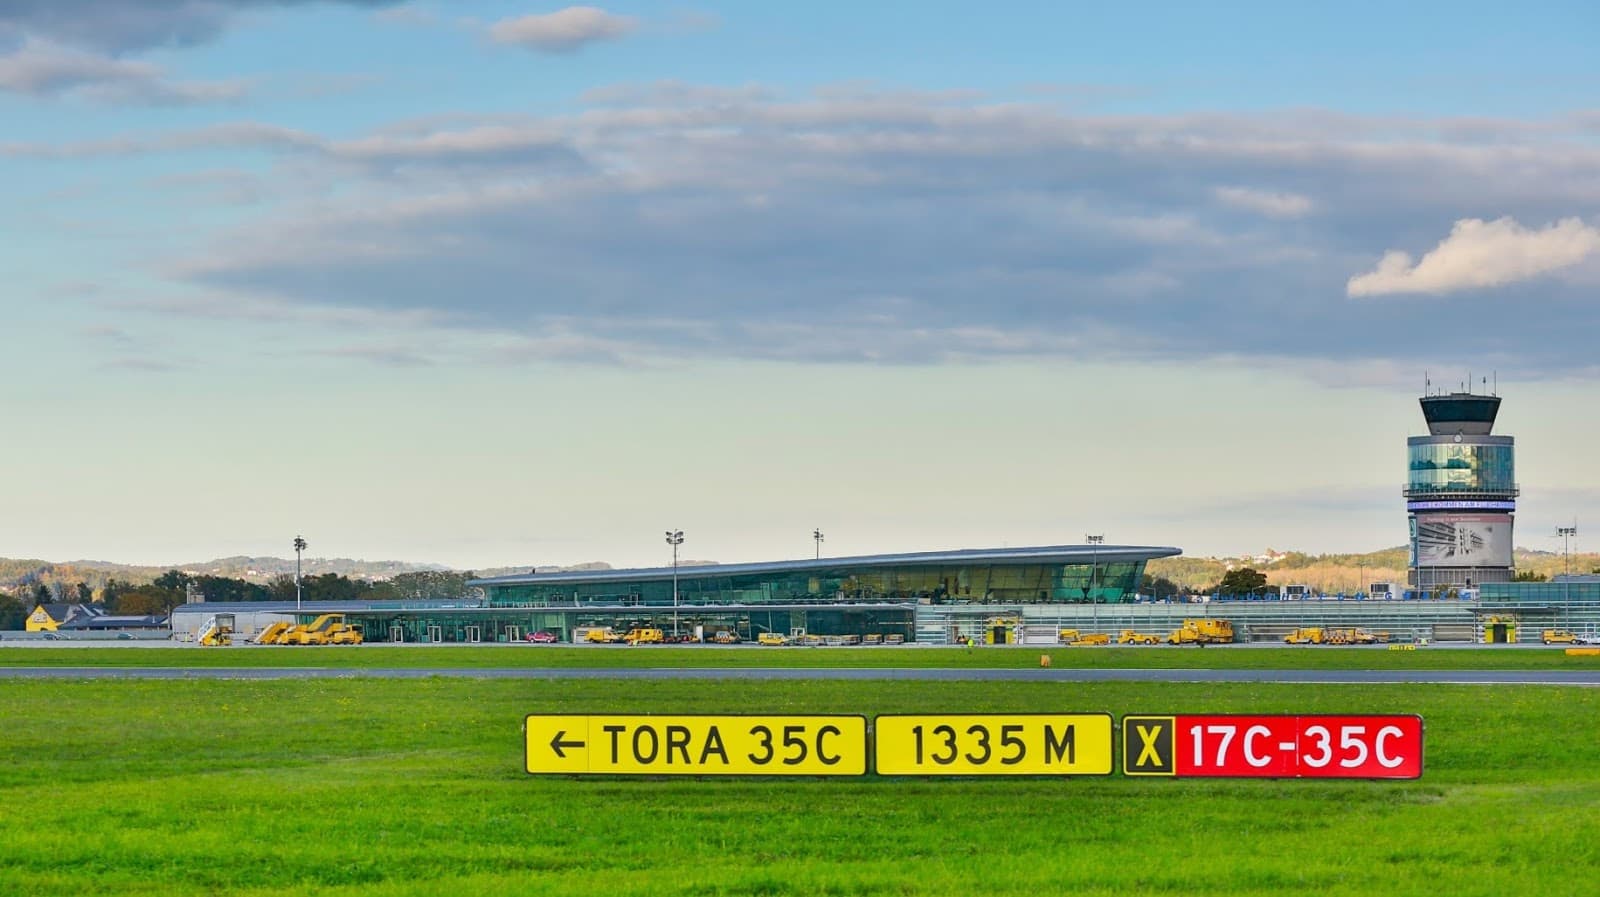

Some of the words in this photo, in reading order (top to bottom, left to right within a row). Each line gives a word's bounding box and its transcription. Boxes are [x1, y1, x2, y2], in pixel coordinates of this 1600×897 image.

[603, 725, 730, 765] TORA
[747, 725, 841, 766] 35C
[912, 725, 1027, 765] 1335
[1044, 725, 1075, 765] M
[1135, 725, 1163, 767] X
[1190, 725, 1404, 768] 17C-35C
